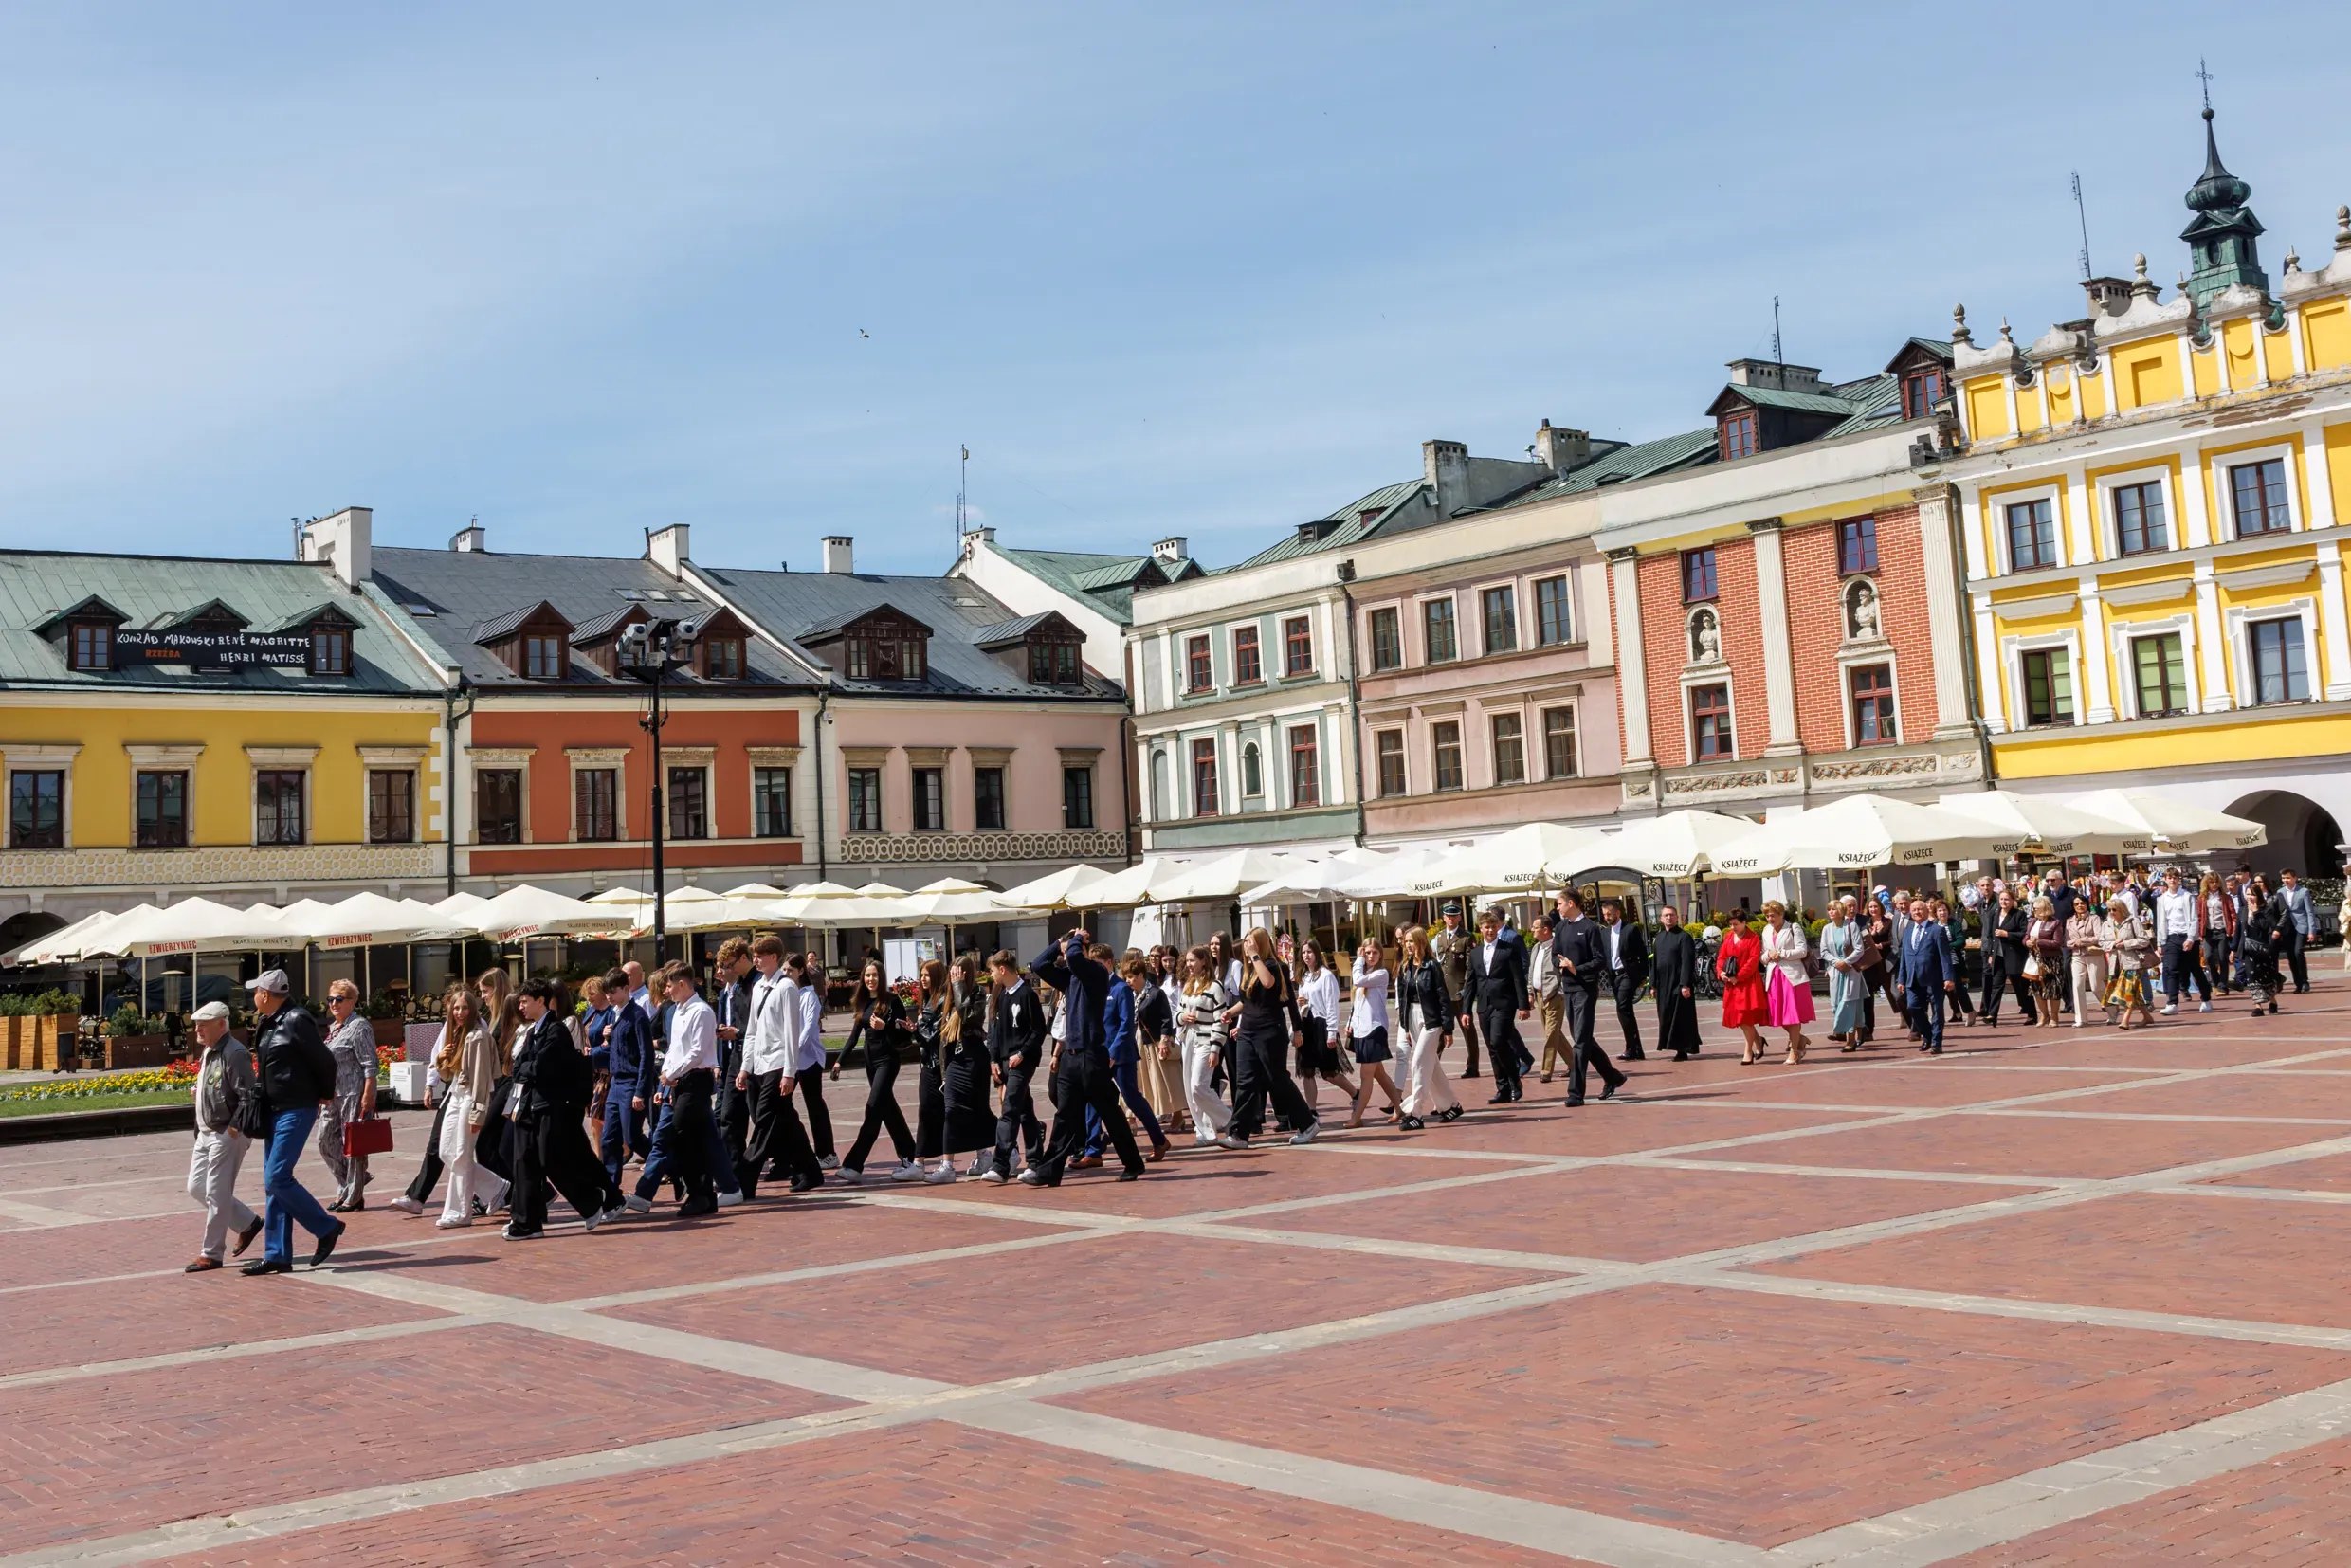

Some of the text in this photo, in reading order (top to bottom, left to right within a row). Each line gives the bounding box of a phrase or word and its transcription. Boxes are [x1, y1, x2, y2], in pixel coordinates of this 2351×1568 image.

[117, 632, 158, 645] KONRAD
[218, 633, 310, 647] RENÉ MAGRITTE
[220, 652, 305, 664] HENRI MATISSE
[1903, 848, 1933, 860] KSIĄŻĘCE
[1652, 861, 1687, 872] KSIĄŻĘCE
[1721, 857, 1758, 869] KSIĄŻĘCE
[1414, 880, 1443, 892] KSIĄŻĘCE
